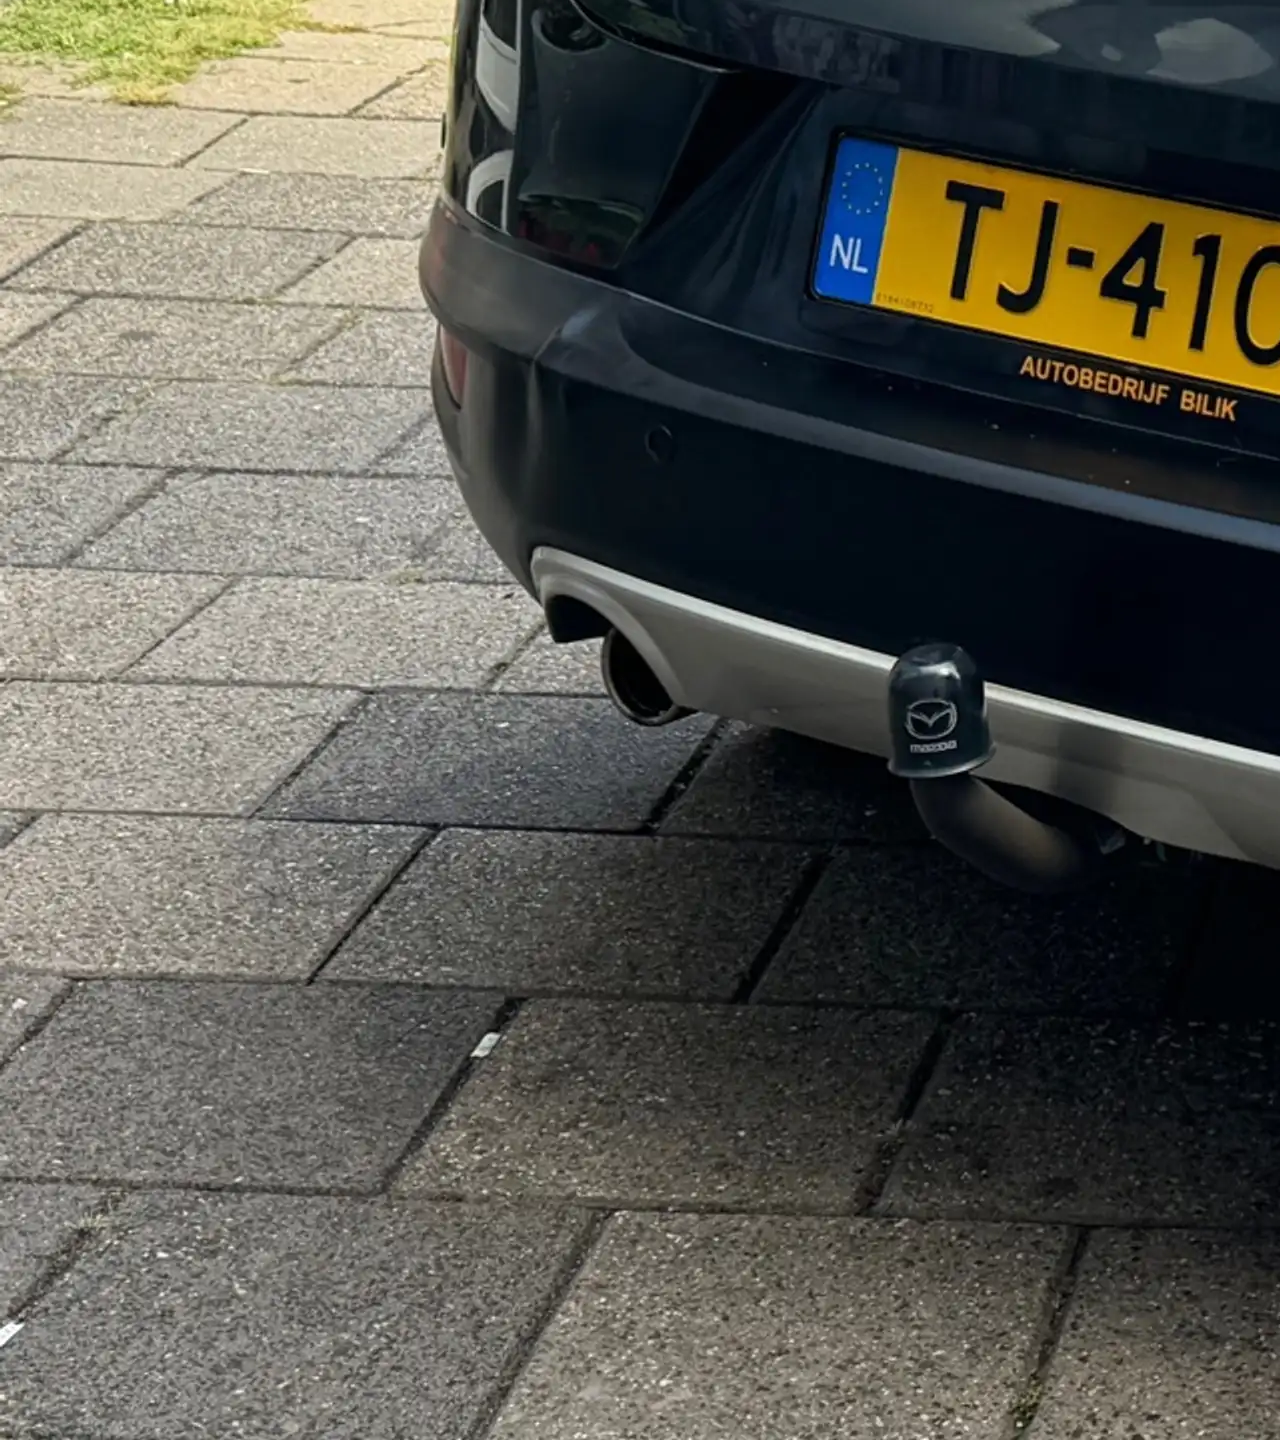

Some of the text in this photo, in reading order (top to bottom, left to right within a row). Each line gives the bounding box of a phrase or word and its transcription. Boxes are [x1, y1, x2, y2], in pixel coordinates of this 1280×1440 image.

[828, 232, 869, 275] NL
[1019, 354, 1239, 423] AUTOBEDRIJF BILIK
[910, 740, 958, 753] mazda
